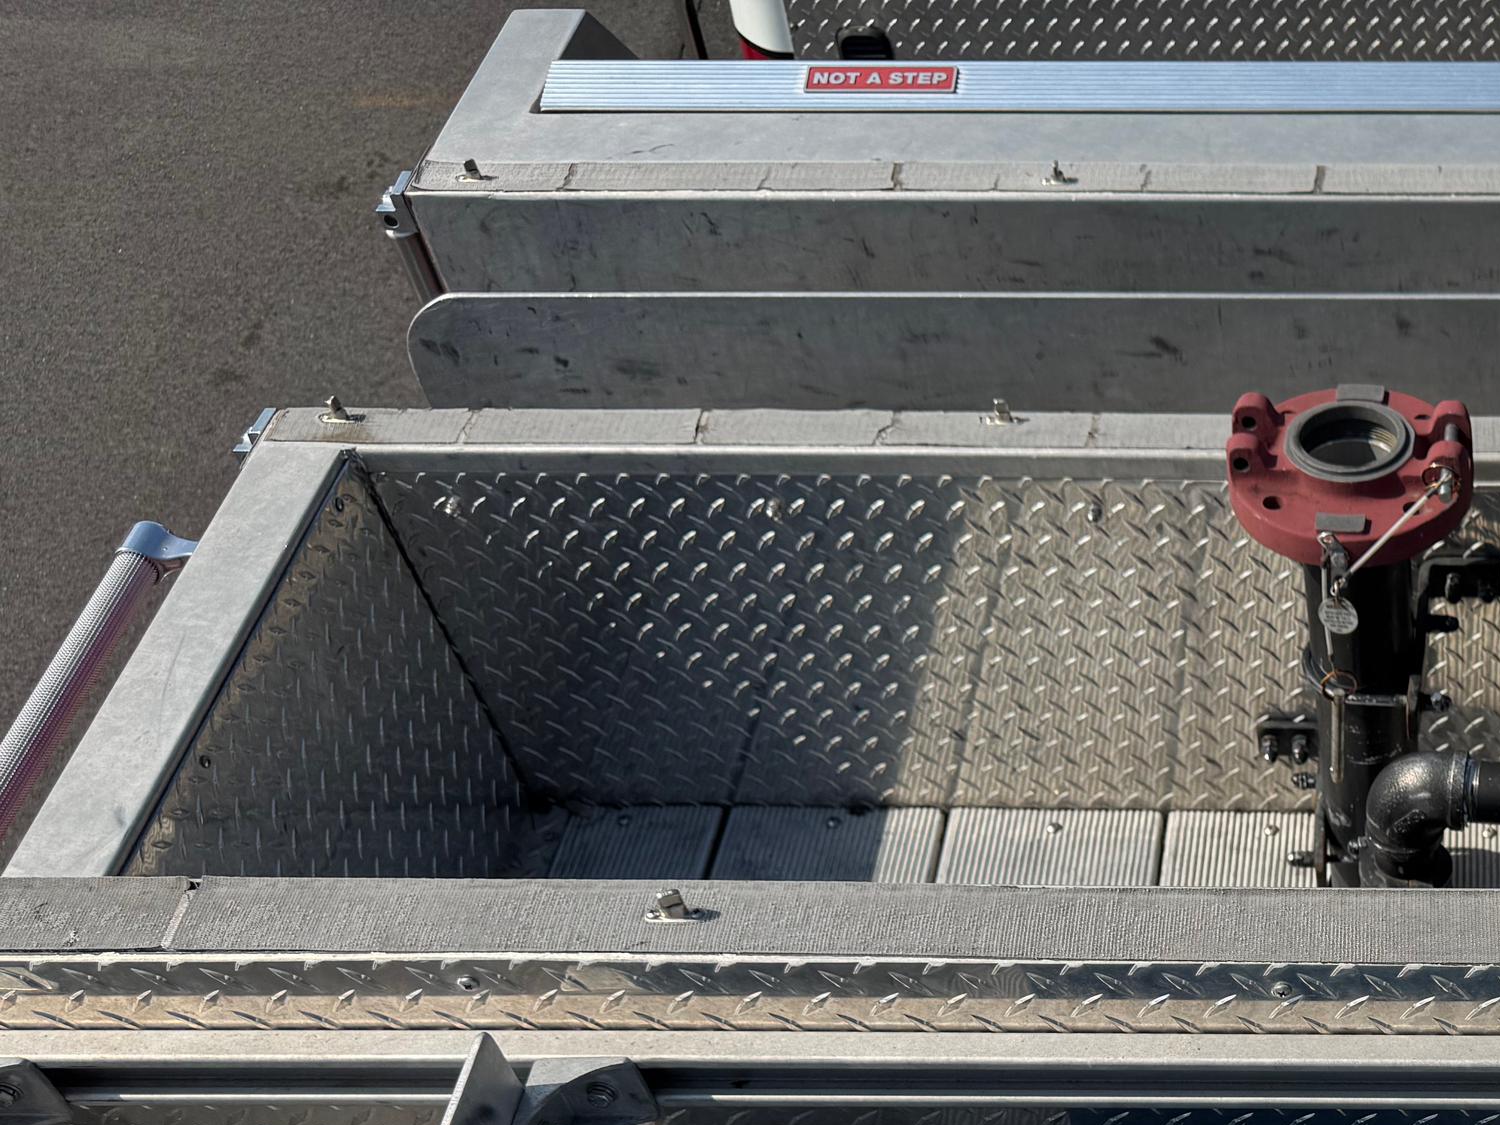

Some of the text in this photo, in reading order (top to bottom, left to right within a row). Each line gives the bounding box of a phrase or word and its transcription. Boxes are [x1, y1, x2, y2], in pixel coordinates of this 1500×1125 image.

[812, 71, 948, 85] NOT A STEP
